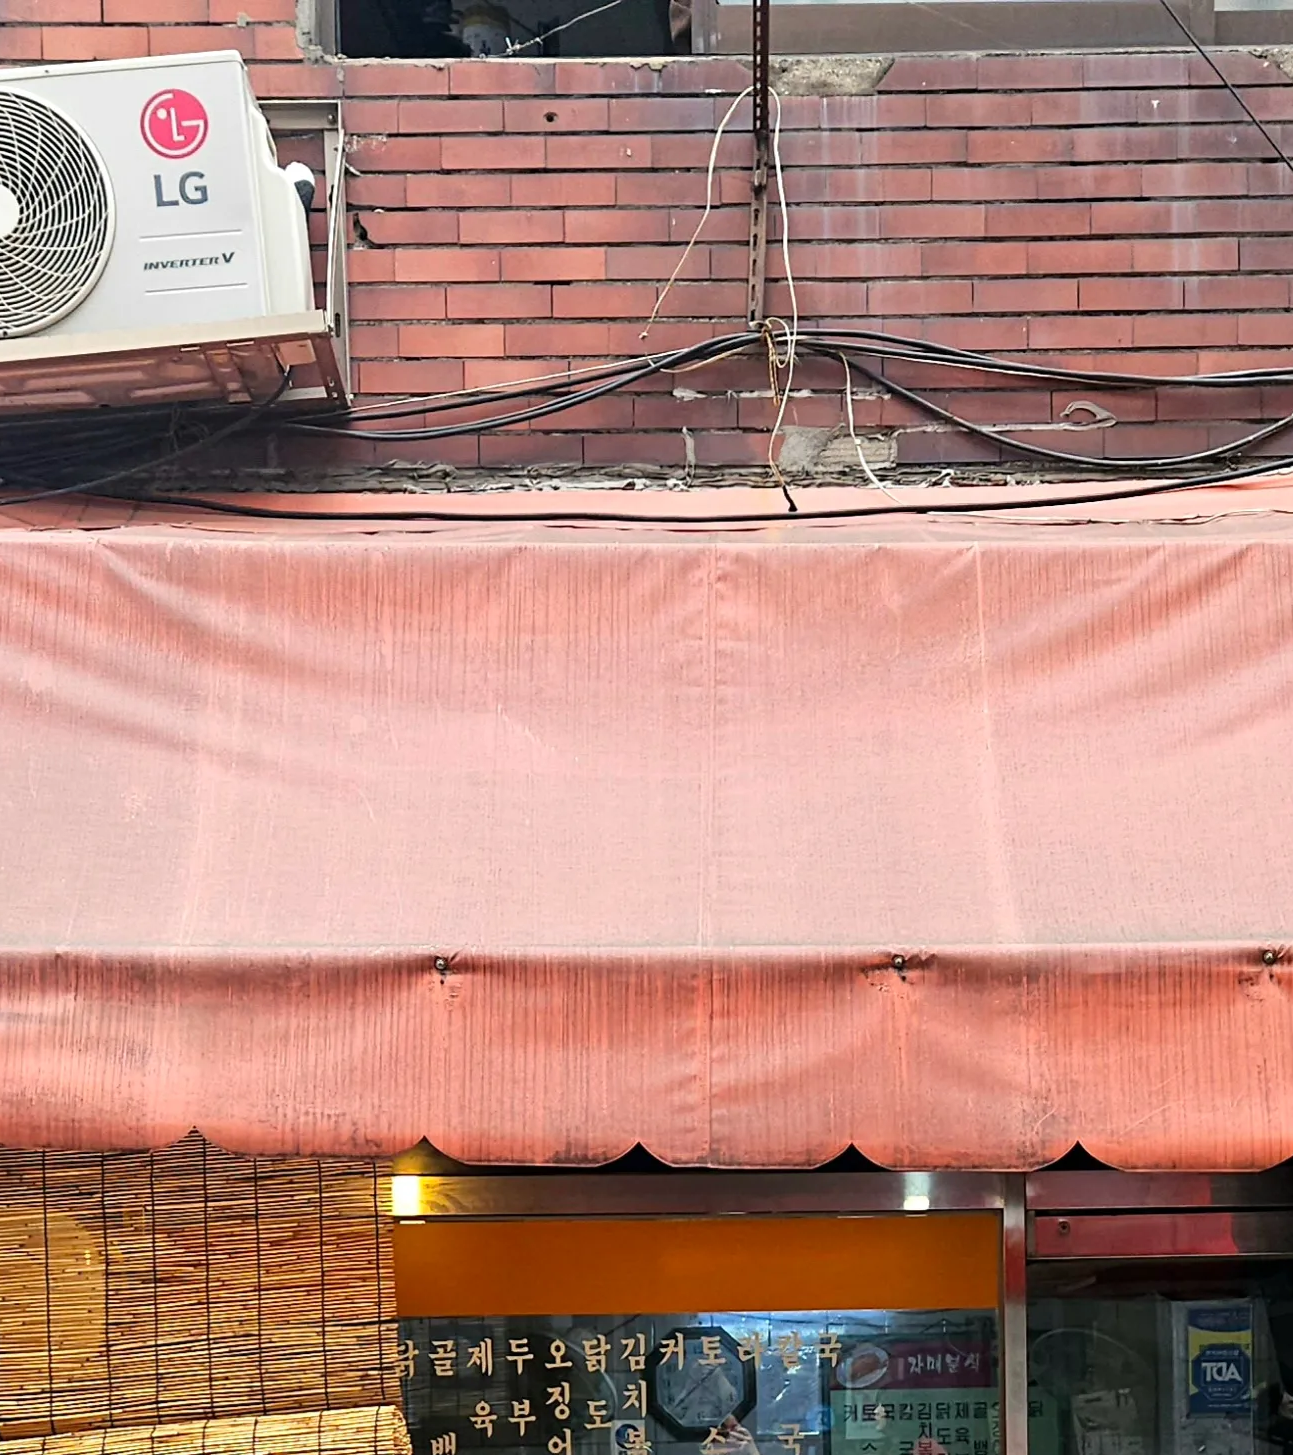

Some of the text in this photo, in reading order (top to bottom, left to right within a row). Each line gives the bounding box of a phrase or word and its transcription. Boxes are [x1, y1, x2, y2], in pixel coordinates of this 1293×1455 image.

[153, 170, 209, 208] LG
[143, 251, 235, 271] INVERTER V
